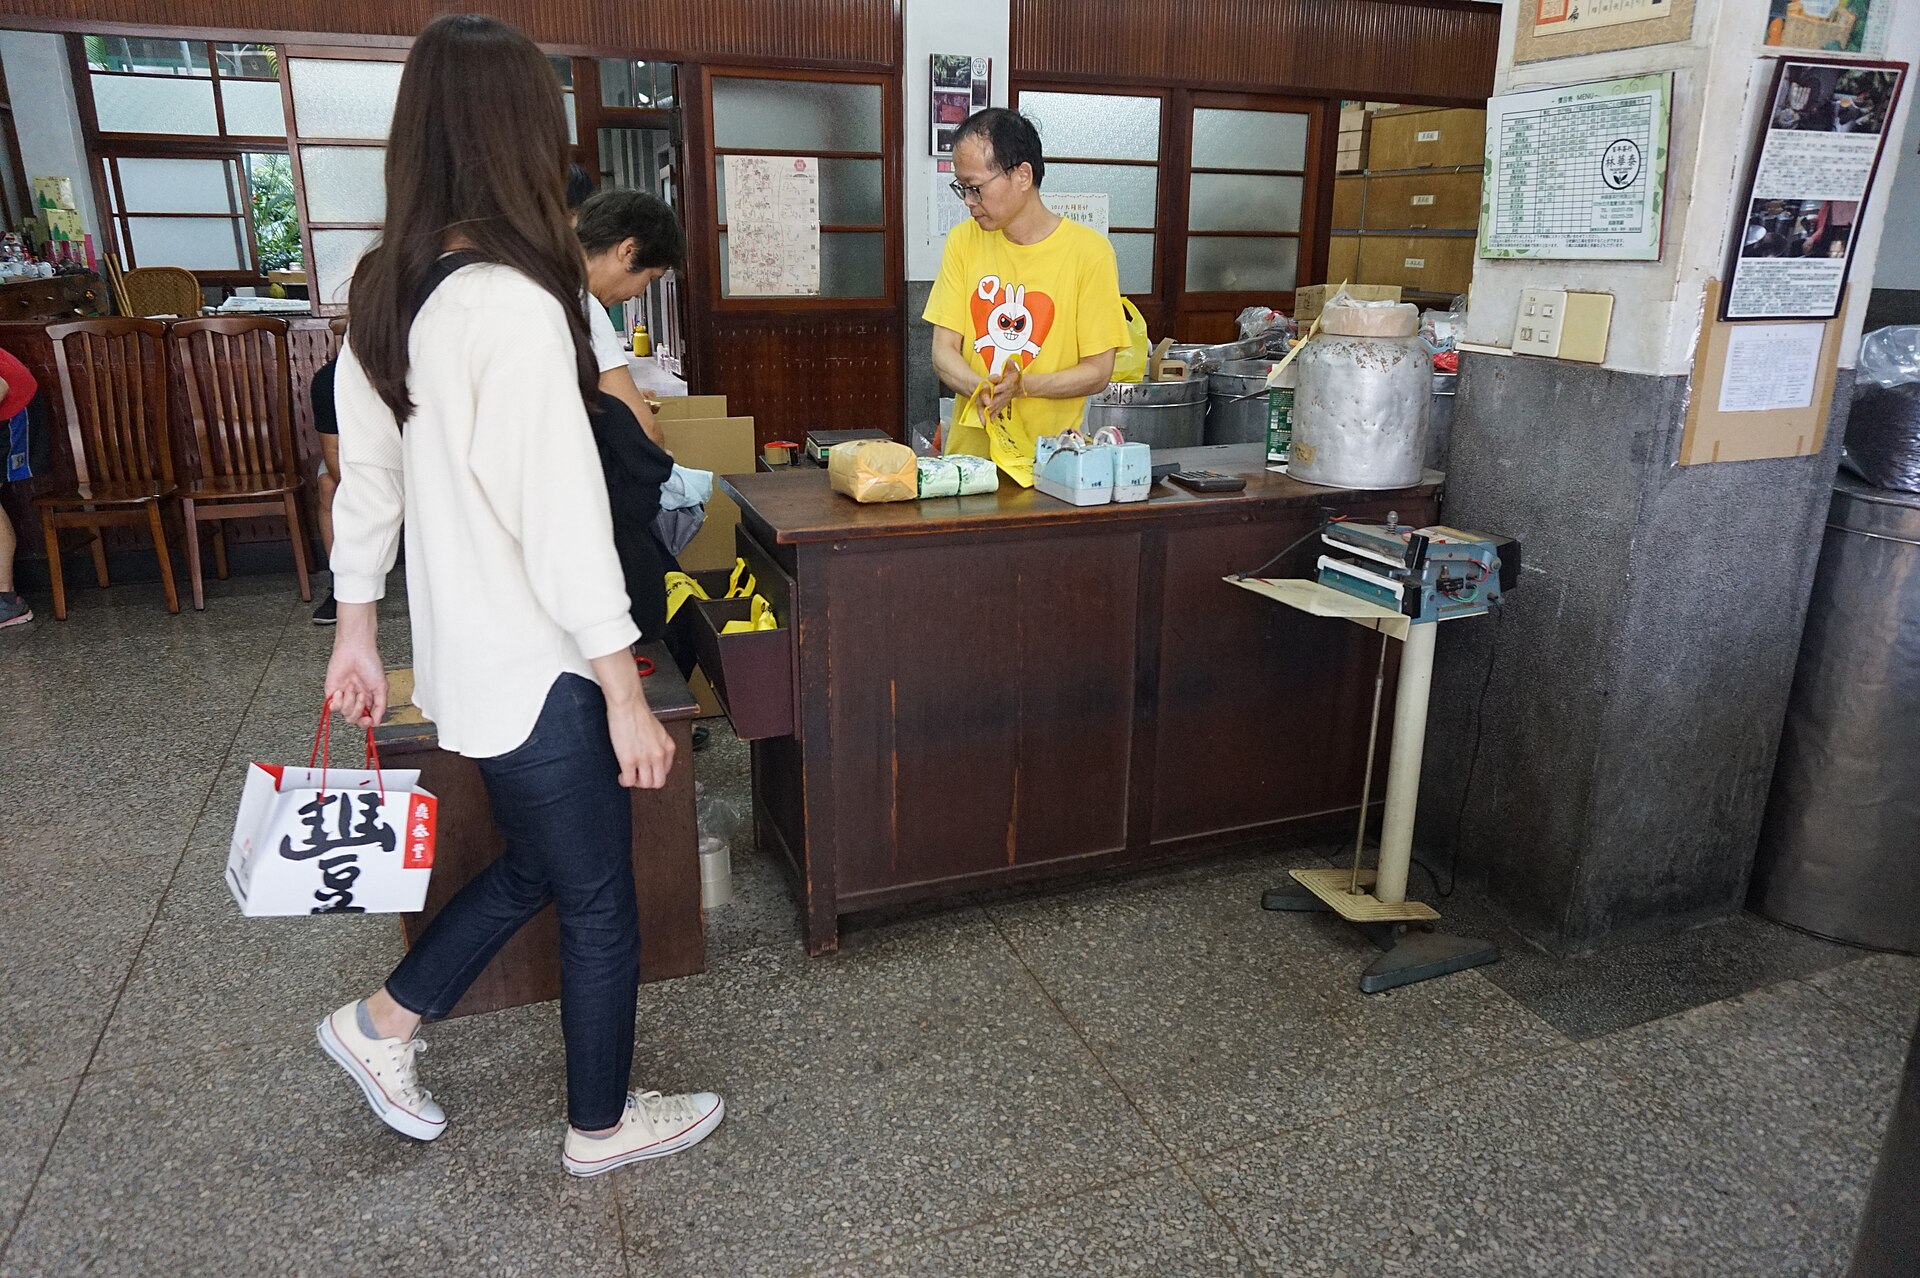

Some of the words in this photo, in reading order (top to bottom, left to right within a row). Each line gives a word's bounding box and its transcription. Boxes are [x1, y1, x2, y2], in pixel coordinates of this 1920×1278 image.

[1576, 93, 1594, 101] MENU
[1606, 154, 1637, 168] 林華泰
